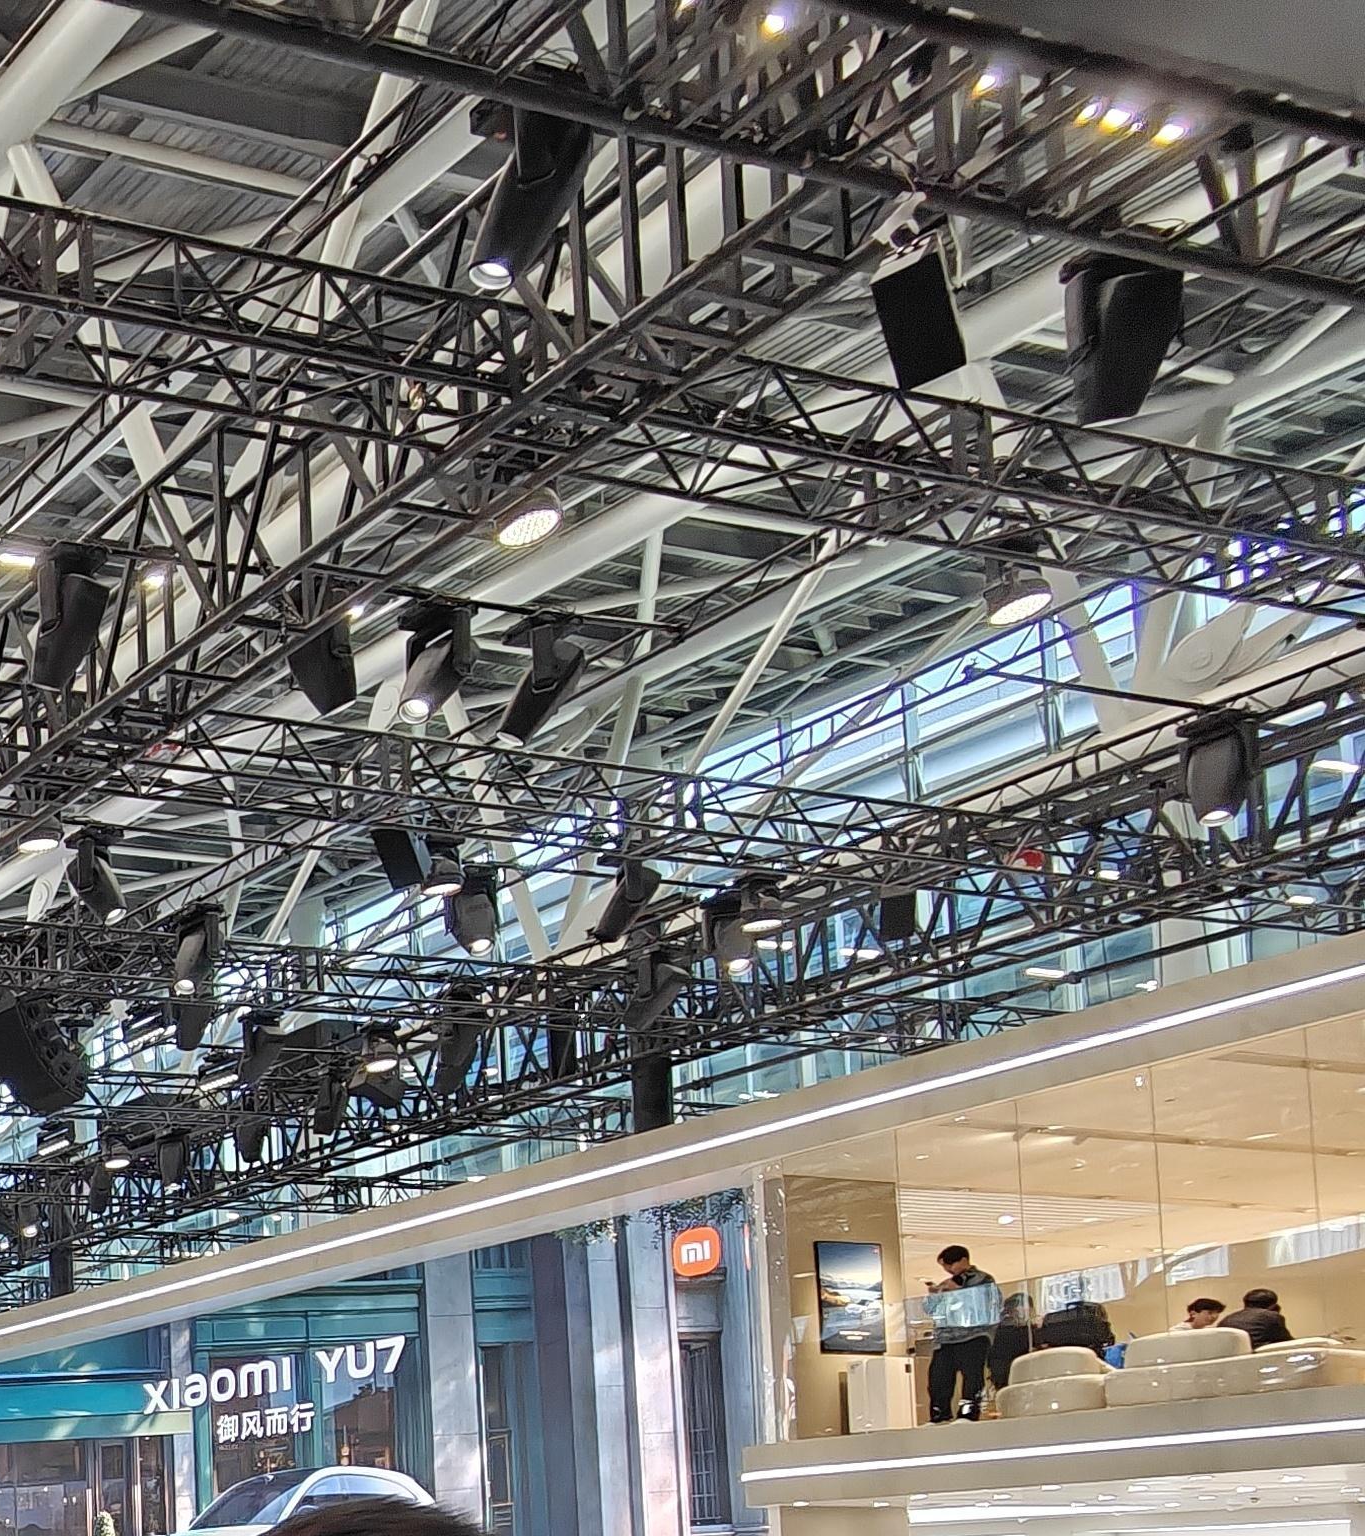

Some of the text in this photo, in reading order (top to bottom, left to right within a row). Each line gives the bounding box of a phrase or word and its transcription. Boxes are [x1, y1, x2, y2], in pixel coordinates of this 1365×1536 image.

[315, 1335, 406, 1384] YU7
[216, 1402, 316, 1443] 御风而行
